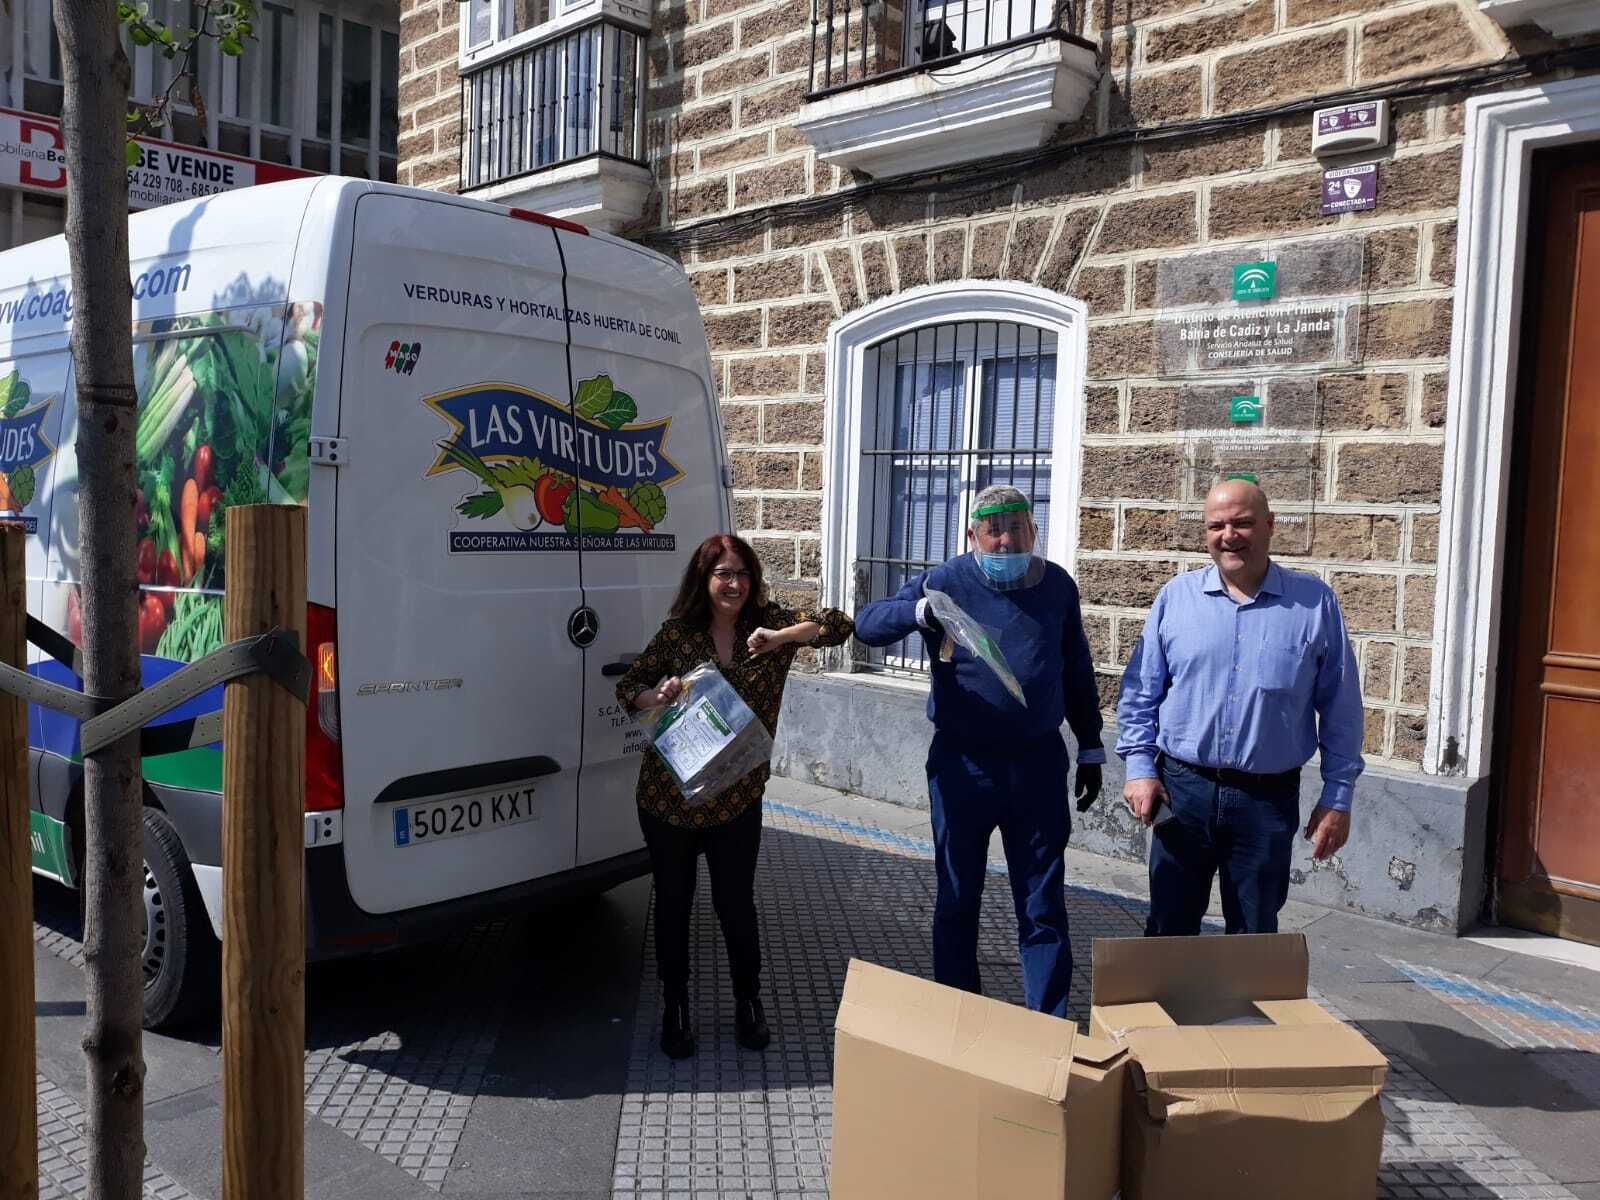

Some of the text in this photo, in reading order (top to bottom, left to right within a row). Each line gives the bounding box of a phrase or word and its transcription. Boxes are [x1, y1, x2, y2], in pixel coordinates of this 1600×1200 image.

[166, 152, 234, 185] VENDE
[143, 173, 161, 189] 229
[165, 177, 183, 193] 708
[191, 182, 210, 197] 685
[1328, 181, 1340, 191] 24
[403, 283, 682, 345] VERDURAS Y HORTALIZAS HUERTA DE CONIL
[1213, 325, 1227, 338] de
[1263, 325, 1271, 337] y
[1276, 321, 1291, 334] La
[1293, 318, 1331, 333] Janda
[1255, 348, 1266, 357] DE
[1267, 347, 1293, 356] SALUD
[468, 404, 657, 478] LAS VIRTUDES
[1180, 511, 1203, 520] Unidad
[453, 534, 674, 549] COOPERATIVA NUESTRA SEÑORA DE LAS VIRTUDES
[356, 678, 464, 696] SPRINTER
[414, 788, 535, 839] 5020 KXT
